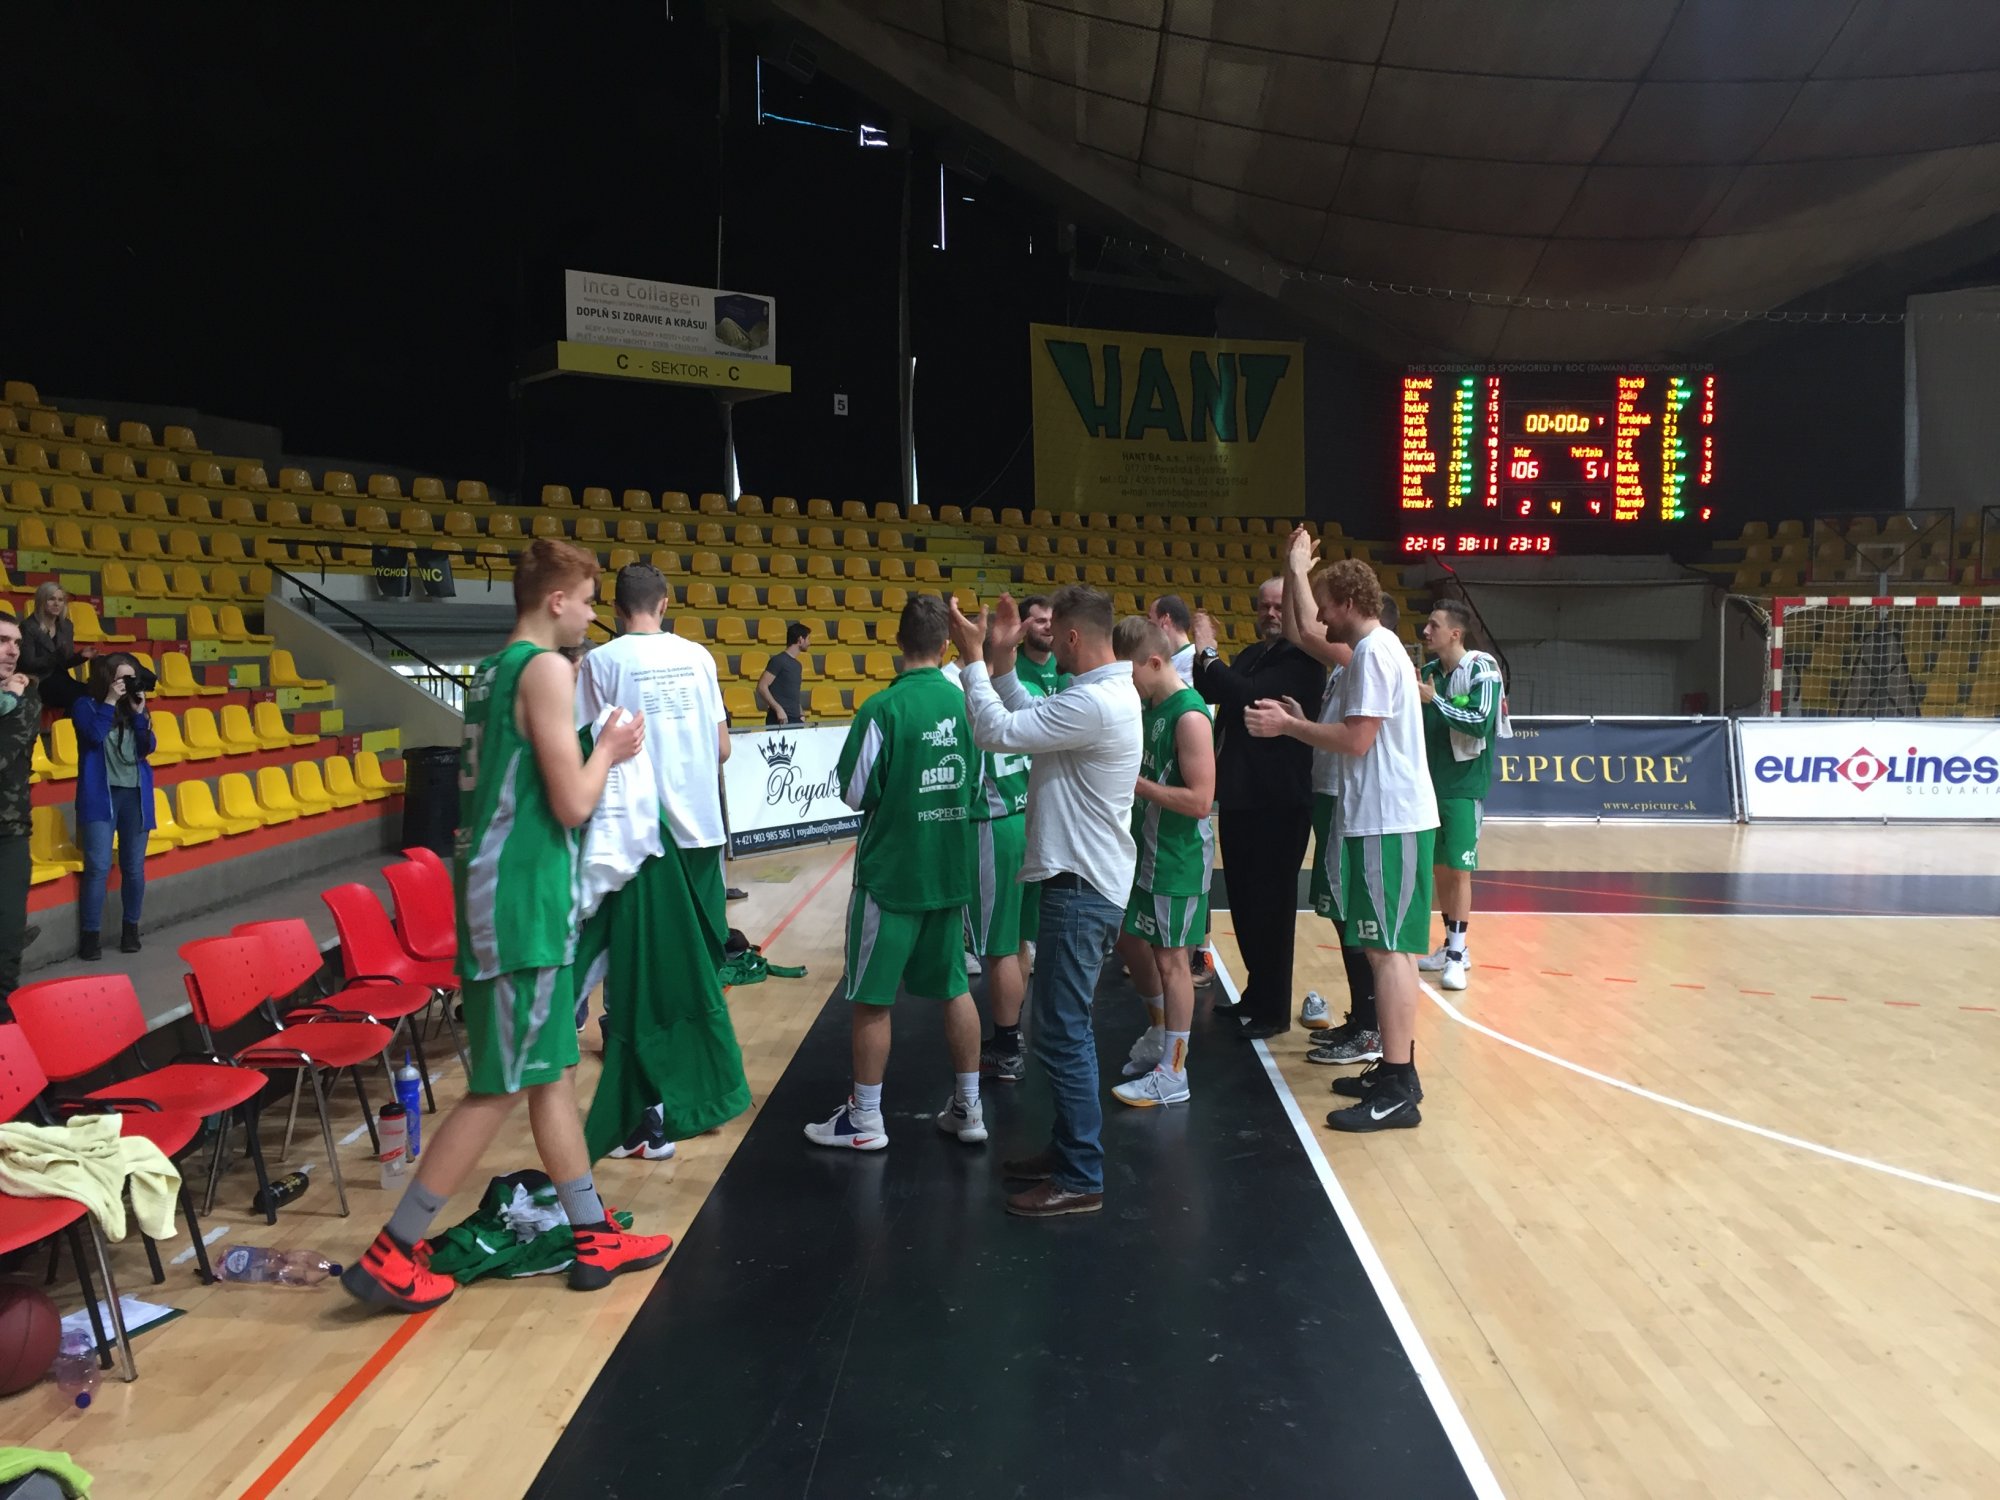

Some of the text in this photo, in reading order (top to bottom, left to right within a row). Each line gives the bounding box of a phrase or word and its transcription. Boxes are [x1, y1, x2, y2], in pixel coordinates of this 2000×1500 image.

[584, 276, 620, 297] Inca
[626, 282, 700, 308] Collagen
[576, 306, 708, 330] DOPLŇ SI ZDRAVIE A KRÁSU!
[616, 354, 629, 370] C
[651, 360, 708, 378] SEKTOR
[728, 366, 740, 381] C
[1408, 364, 1427, 374] THIS
[1428, 364, 1486, 374] SCOREBOARD
[1488, 364, 1496, 374] IS
[1497, 364, 1550, 374] SPONSORED
[1552, 364, 1563, 374] BY
[1628, 364, 1688, 374] DEVELOPMENT
[1690, 364, 1714, 374] FUND
[1489, 378, 1500, 386] 11
[1670, 378, 1678, 387] 4
[1706, 378, 1714, 387] 2
[1044, 338, 1291, 443] HANT
[1456, 390, 1464, 400] 9
[1492, 390, 1500, 400] 2
[1668, 390, 1678, 400] 12
[1706, 390, 1714, 399] 4
[838, 400, 845, 410] 5
[1453, 402, 1463, 412] 12
[1488, 402, 1498, 412] 15
[1667, 402, 1678, 411] 14
[1453, 414, 1463, 424] 13
[1488, 414, 1498, 423] 17
[1526, 414, 1590, 432] 00:00.0
[1663, 414, 1677, 424] 21
[1702, 414, 1713, 424] 13
[1453, 426, 1462, 436] 15
[1492, 426, 1498, 434] 4
[1663, 426, 1677, 436] 23
[1452, 438, 1462, 447] 17
[1663, 438, 1677, 448] 24
[1705, 437, 1712, 447] 5
[1452, 450, 1462, 459] 19
[1491, 450, 1498, 459] 9
[1514, 446, 1532, 458] Inter
[1663, 449, 1676, 460] 25
[1705, 450, 1712, 459] 4
[1448, 462, 1462, 471] 22
[1490, 462, 1498, 471] 2
[1511, 461, 1610, 479] 106 51
[1663, 462, 1676, 472] 31
[1705, 462, 1712, 471] 3
[1449, 474, 1462, 483] 31
[1490, 474, 1497, 483] 6
[1663, 473, 1675, 484] 32
[1701, 473, 1712, 484] 12
[1448, 486, 1462, 495] 55
[1489, 485, 1497, 495] 8
[1662, 485, 1675, 495] 43
[1448, 497, 1462, 508] 24
[1487, 498, 1497, 506] 14
[1521, 500, 1600, 515] 2 4 4
[1662, 497, 1675, 508] 50
[1662, 509, 1674, 520] 55
[1702, 509, 1710, 520] 2
[1405, 537, 1550, 551] 22:15 38:11 23:13
[420, 568, 443, 582] WC
[1513, 726, 1540, 740] opis
[1498, 754, 1688, 784] EPICURE
[922, 767, 955, 786] ASW
[766, 766, 832, 818] Royal
[1906, 786, 2000, 795] SLOVAKIA
[1603, 800, 1697, 812] www.epicure.sk
[918, 807, 967, 822] PERSPECTA
[735, 819, 858, 846] +421 903 985 585 royalbus@royalbus.sk
[1134, 910, 1155, 936] 55
[1357, 920, 1378, 940] 12
